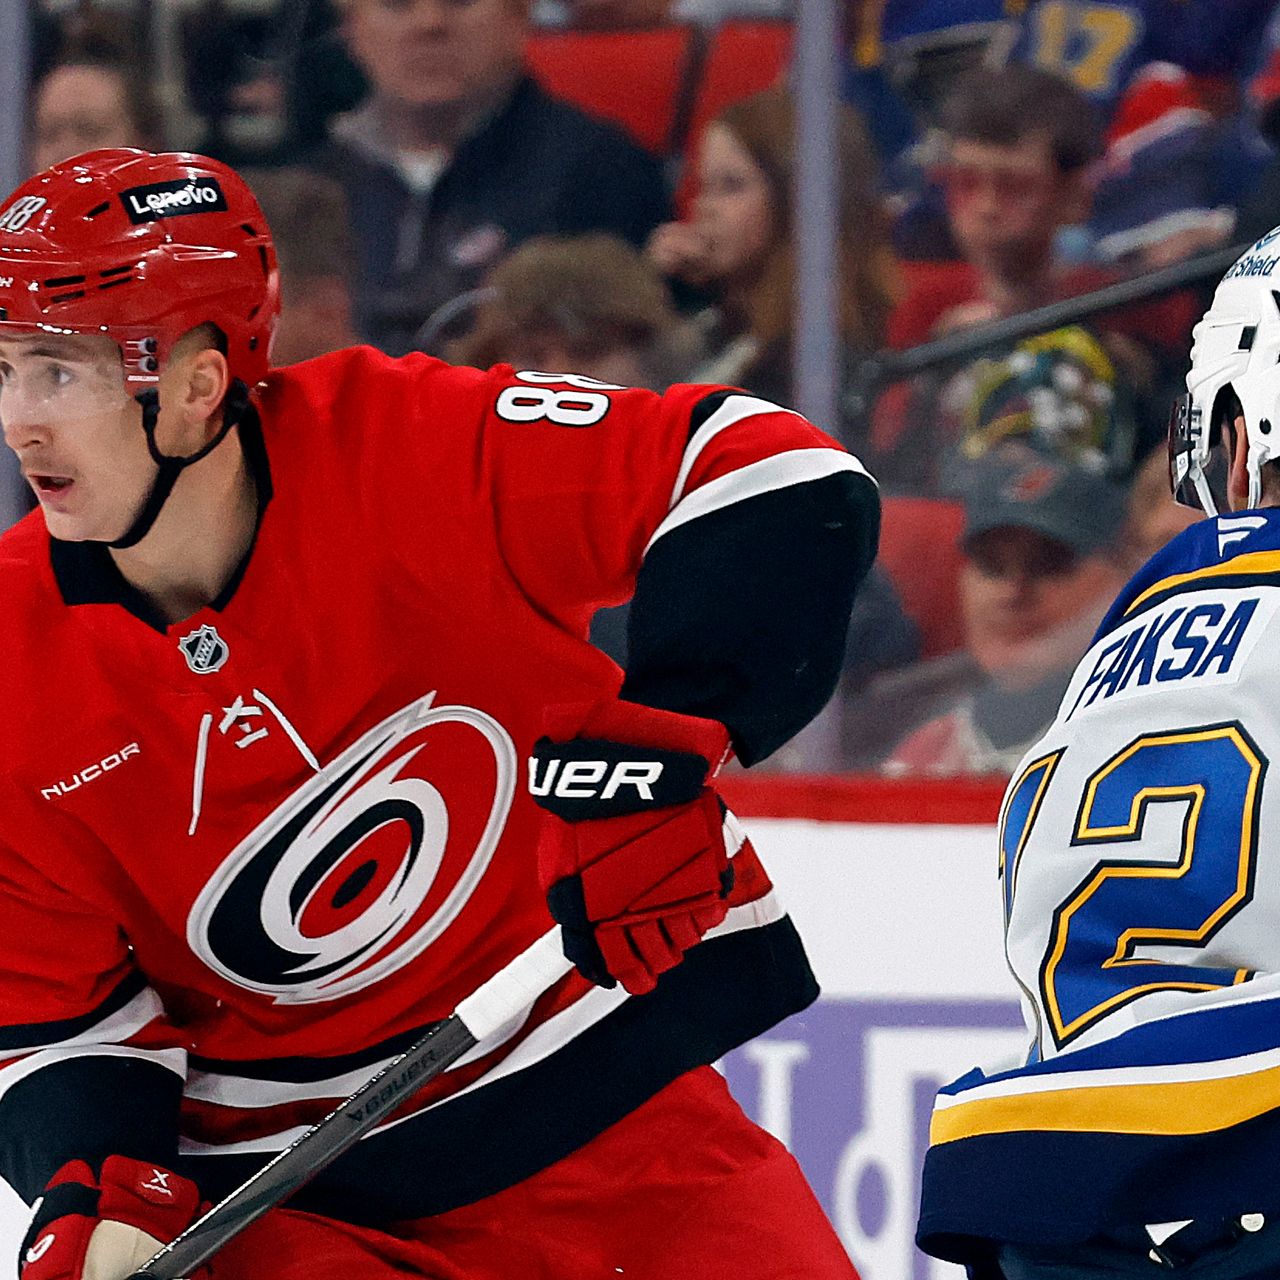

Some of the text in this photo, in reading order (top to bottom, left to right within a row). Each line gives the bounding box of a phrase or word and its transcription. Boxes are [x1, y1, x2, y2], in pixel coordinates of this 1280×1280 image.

[1035, 0, 1136, 91] 17
[129, 185, 219, 217] Lenovo
[1064, 598, 1261, 723] FAKSA
[41, 742, 141, 800] NUCOR
[998, 720, 1270, 1053] 12
